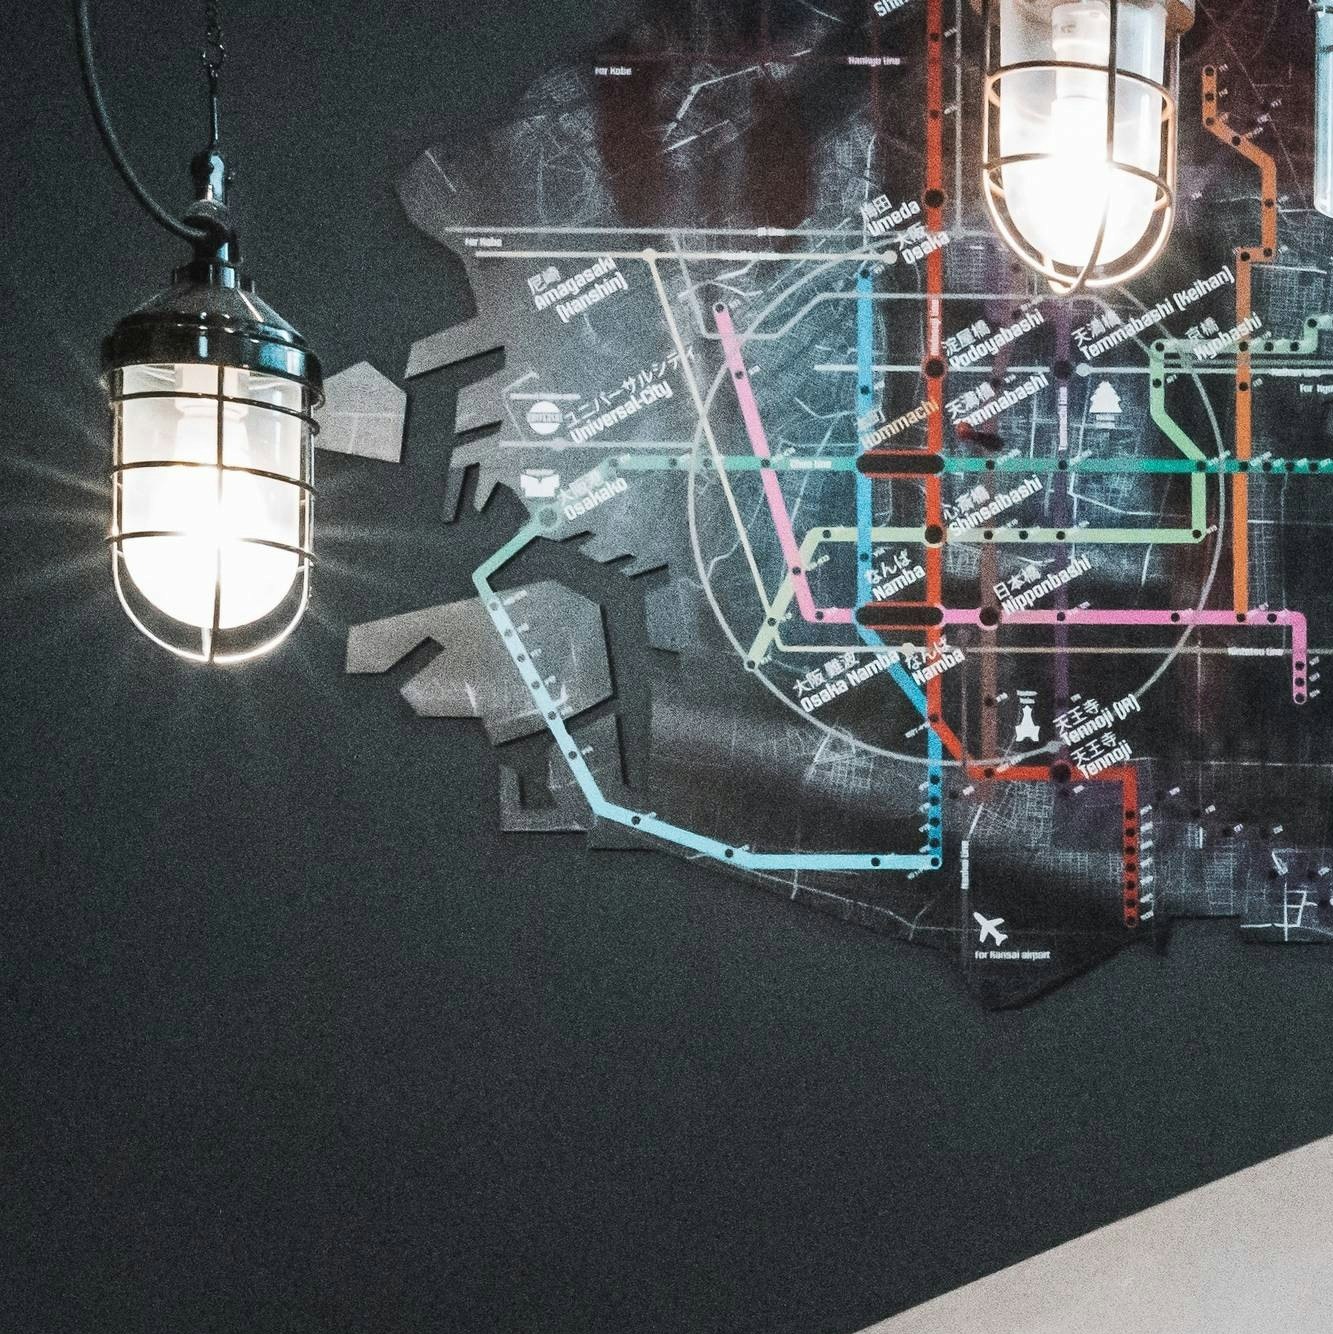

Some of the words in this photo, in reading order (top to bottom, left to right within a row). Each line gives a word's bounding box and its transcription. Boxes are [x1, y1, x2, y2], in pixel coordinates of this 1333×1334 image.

[867, 200, 921, 237] Umeda
[901, 231, 950, 265] Osaka
[563, 477, 628, 521] Osakako
[872, 565, 926, 601] Namba
[1000, 553, 1093, 616] Nipponbashi
[799, 679, 849, 713] Osaka
[847, 650, 901, 687] Namba
[911, 648, 966, 686] Namba
[1052, 698, 1101, 734] 天王寺
[1061, 707, 1116, 747] Tennoji
[1070, 730, 1118, 765] 天王寺
[1077, 739, 1133, 779] Tennoji
